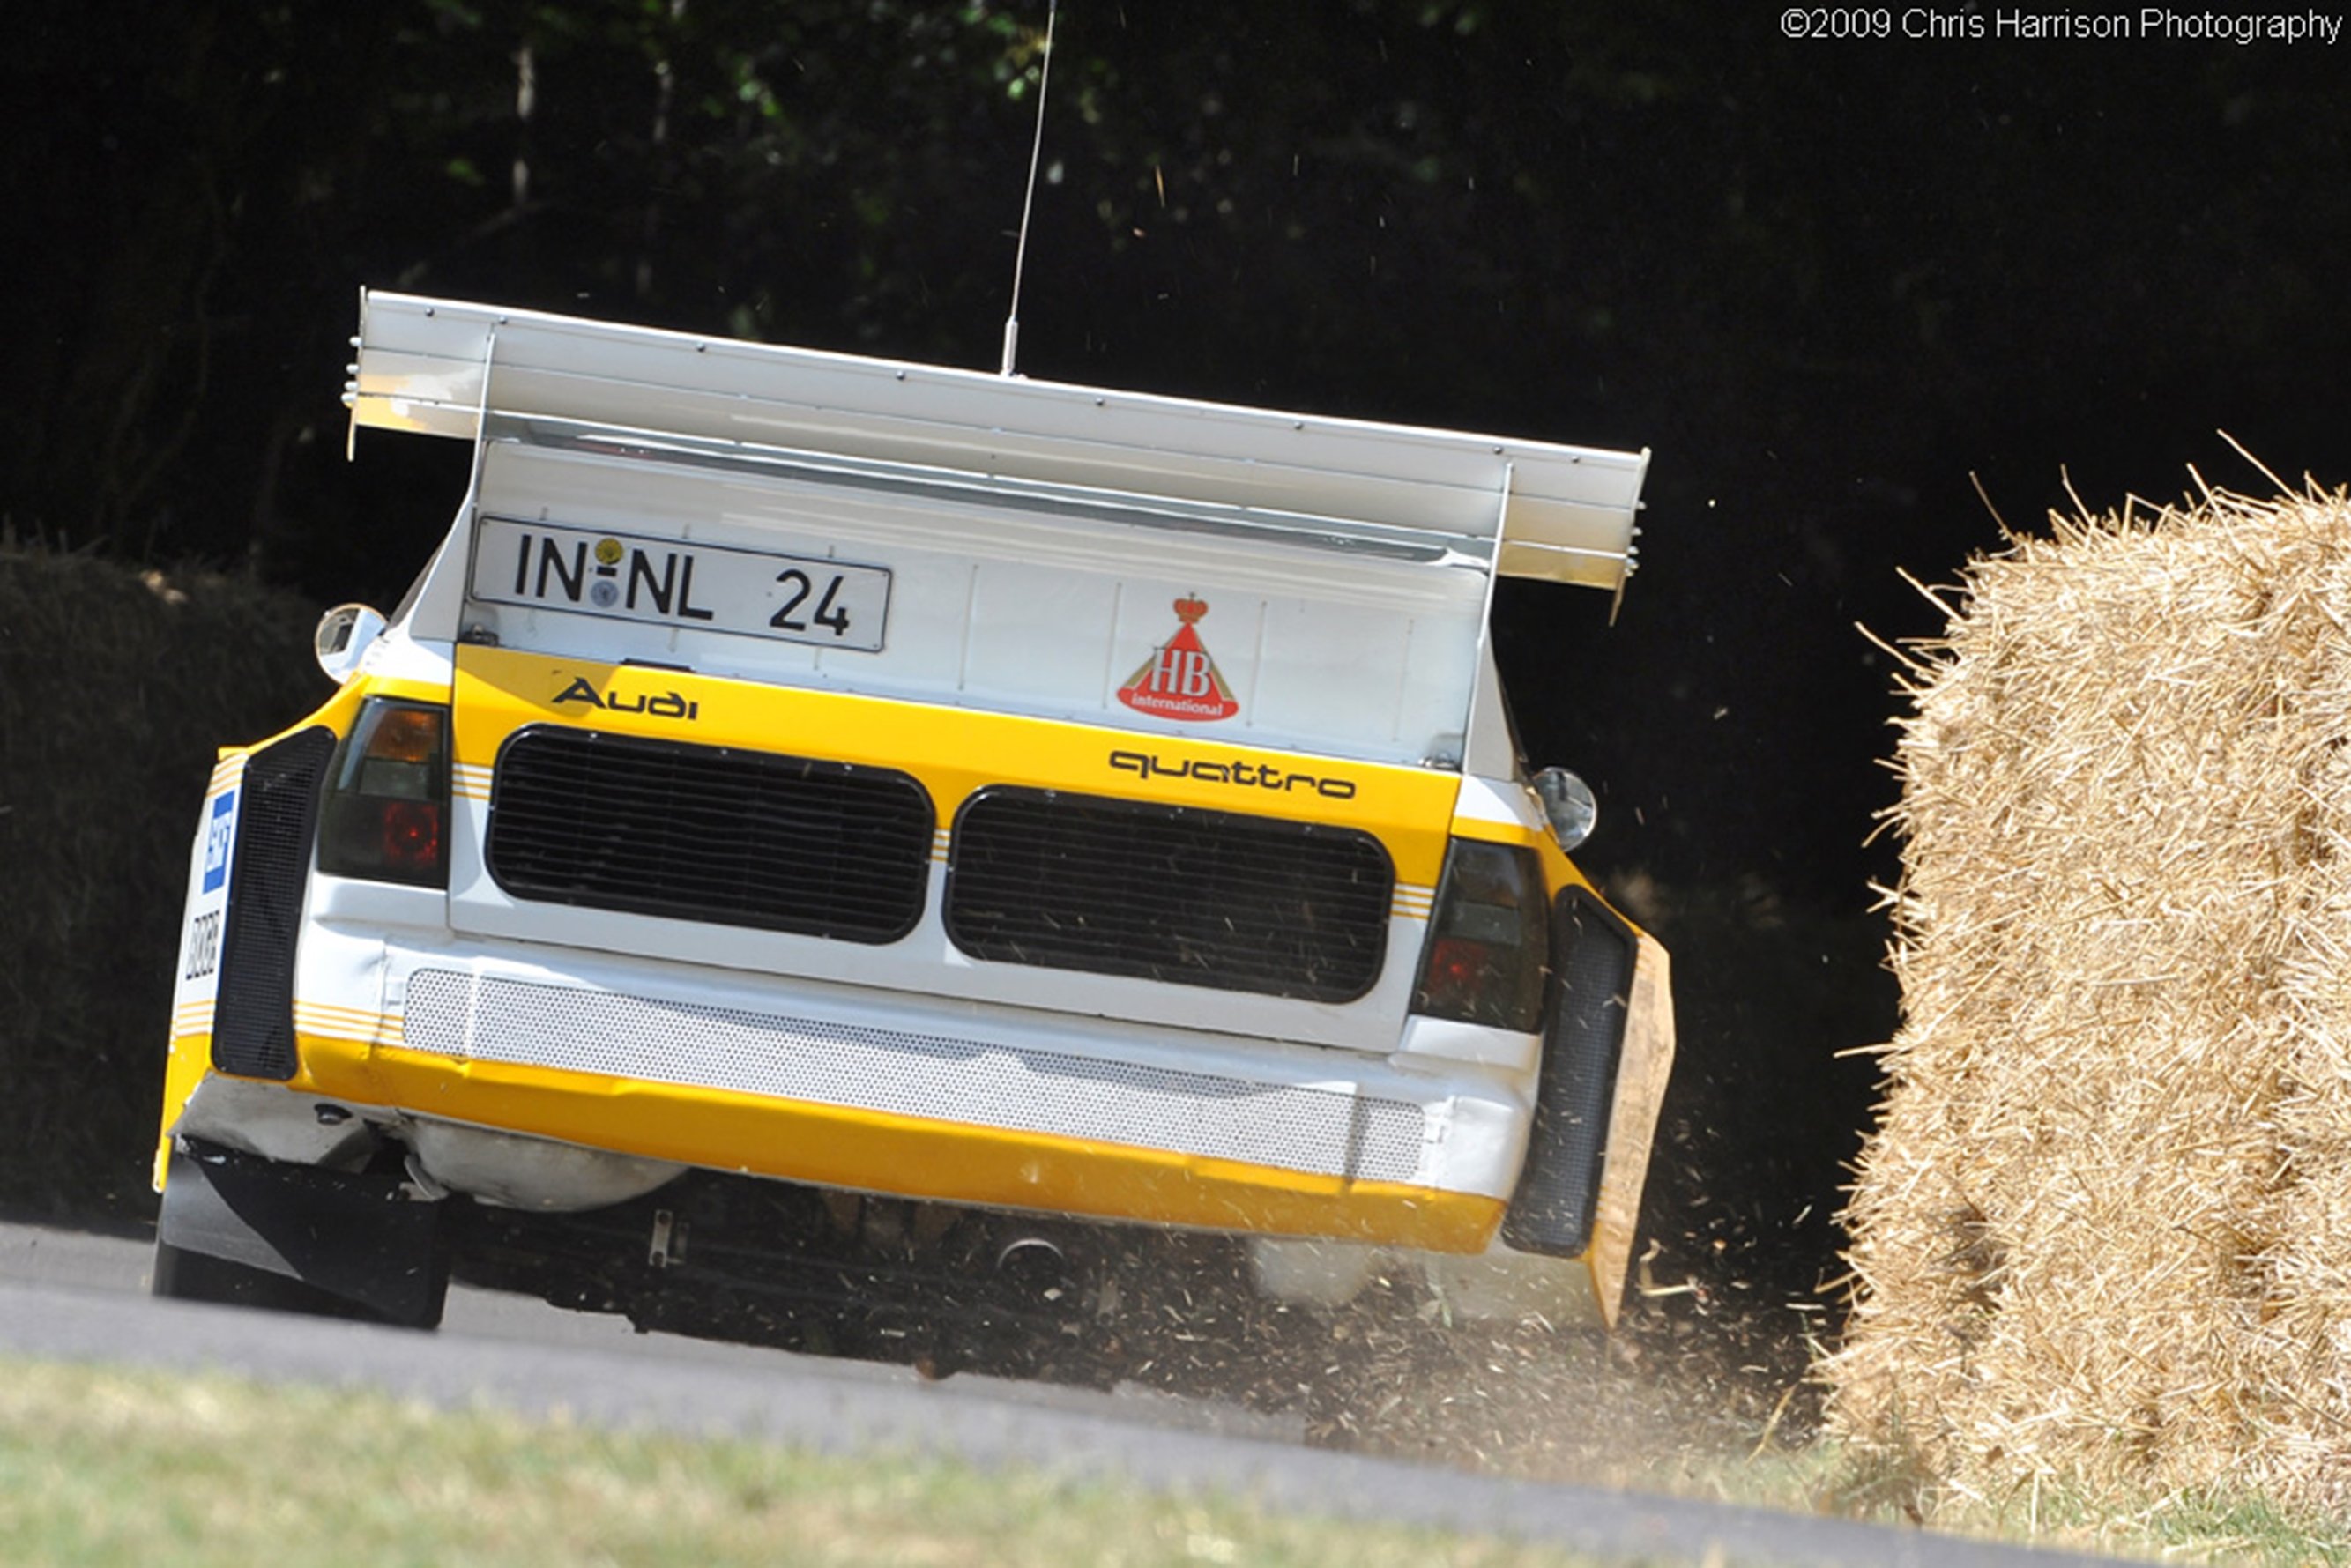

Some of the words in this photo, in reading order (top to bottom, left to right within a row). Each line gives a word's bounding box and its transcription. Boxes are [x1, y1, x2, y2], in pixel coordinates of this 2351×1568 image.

[769, 568, 850, 636] 24
[1149, 645, 1212, 697] HB
[551, 676, 698, 720] Audi
[1131, 692, 1224, 716] international
[1109, 750, 1356, 799] quattro
